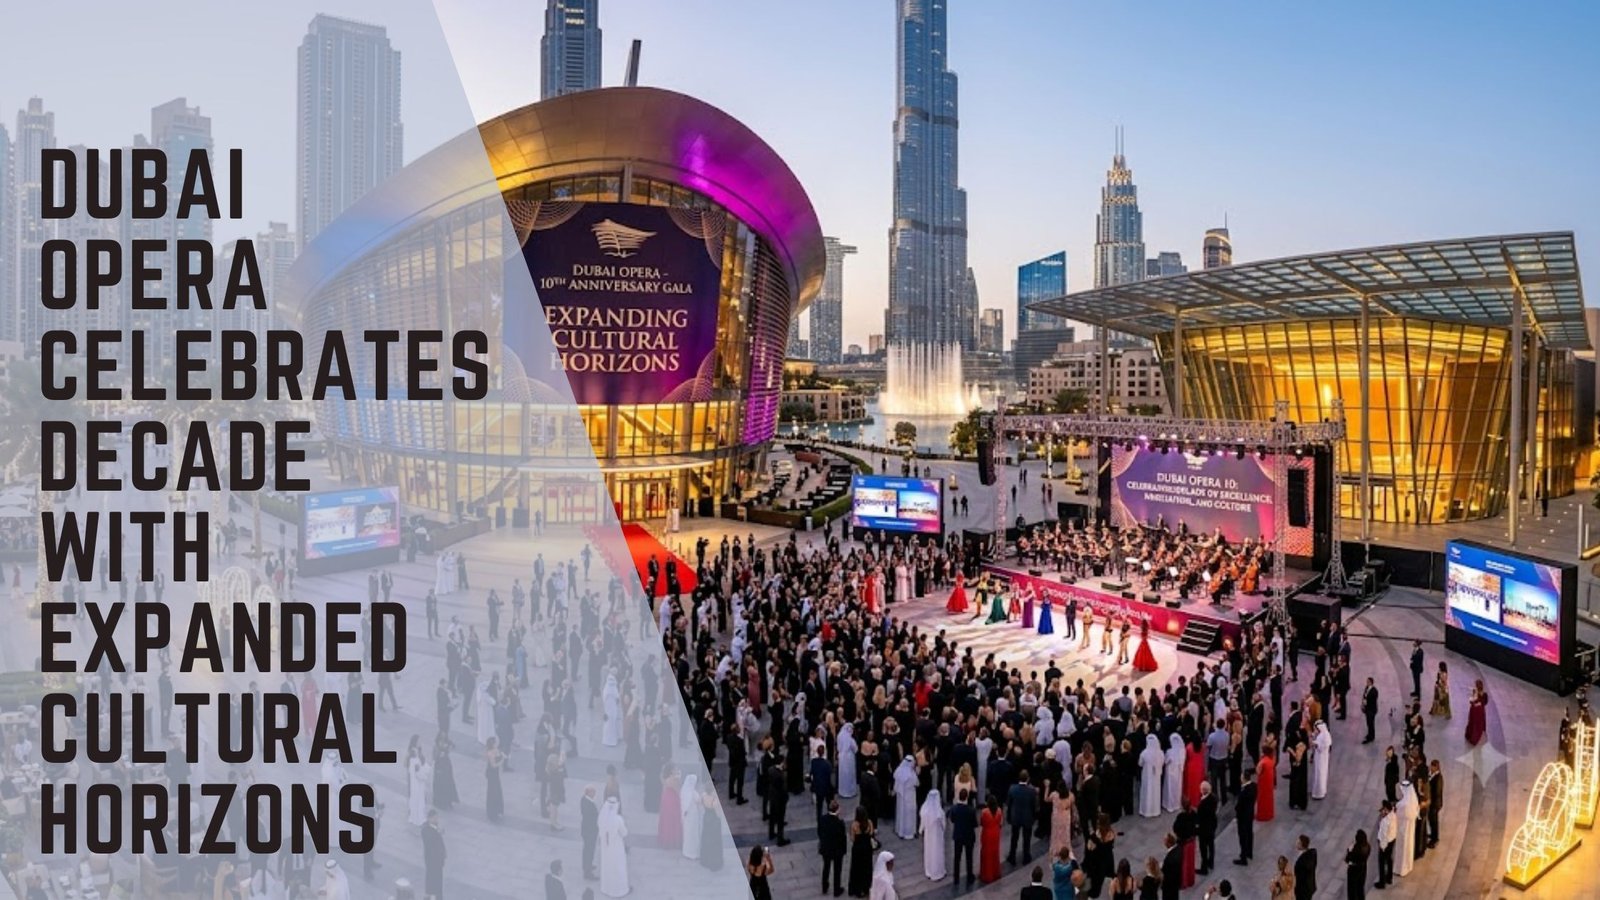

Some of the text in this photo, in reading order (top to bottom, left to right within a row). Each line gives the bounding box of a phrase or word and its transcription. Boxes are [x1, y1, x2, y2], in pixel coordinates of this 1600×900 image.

[572, 264, 615, 277] DUBAI
[619, 266, 661, 279] OPERA
[568, 280, 661, 294] ANNIVERSARY
[663, 281, 693, 294] GALA
[544, 305, 689, 328] EXPANDING
[552, 328, 680, 350] CULTURAL
[550, 352, 680, 373] HORIZONS
[1157, 473, 1187, 484] DUBAI
